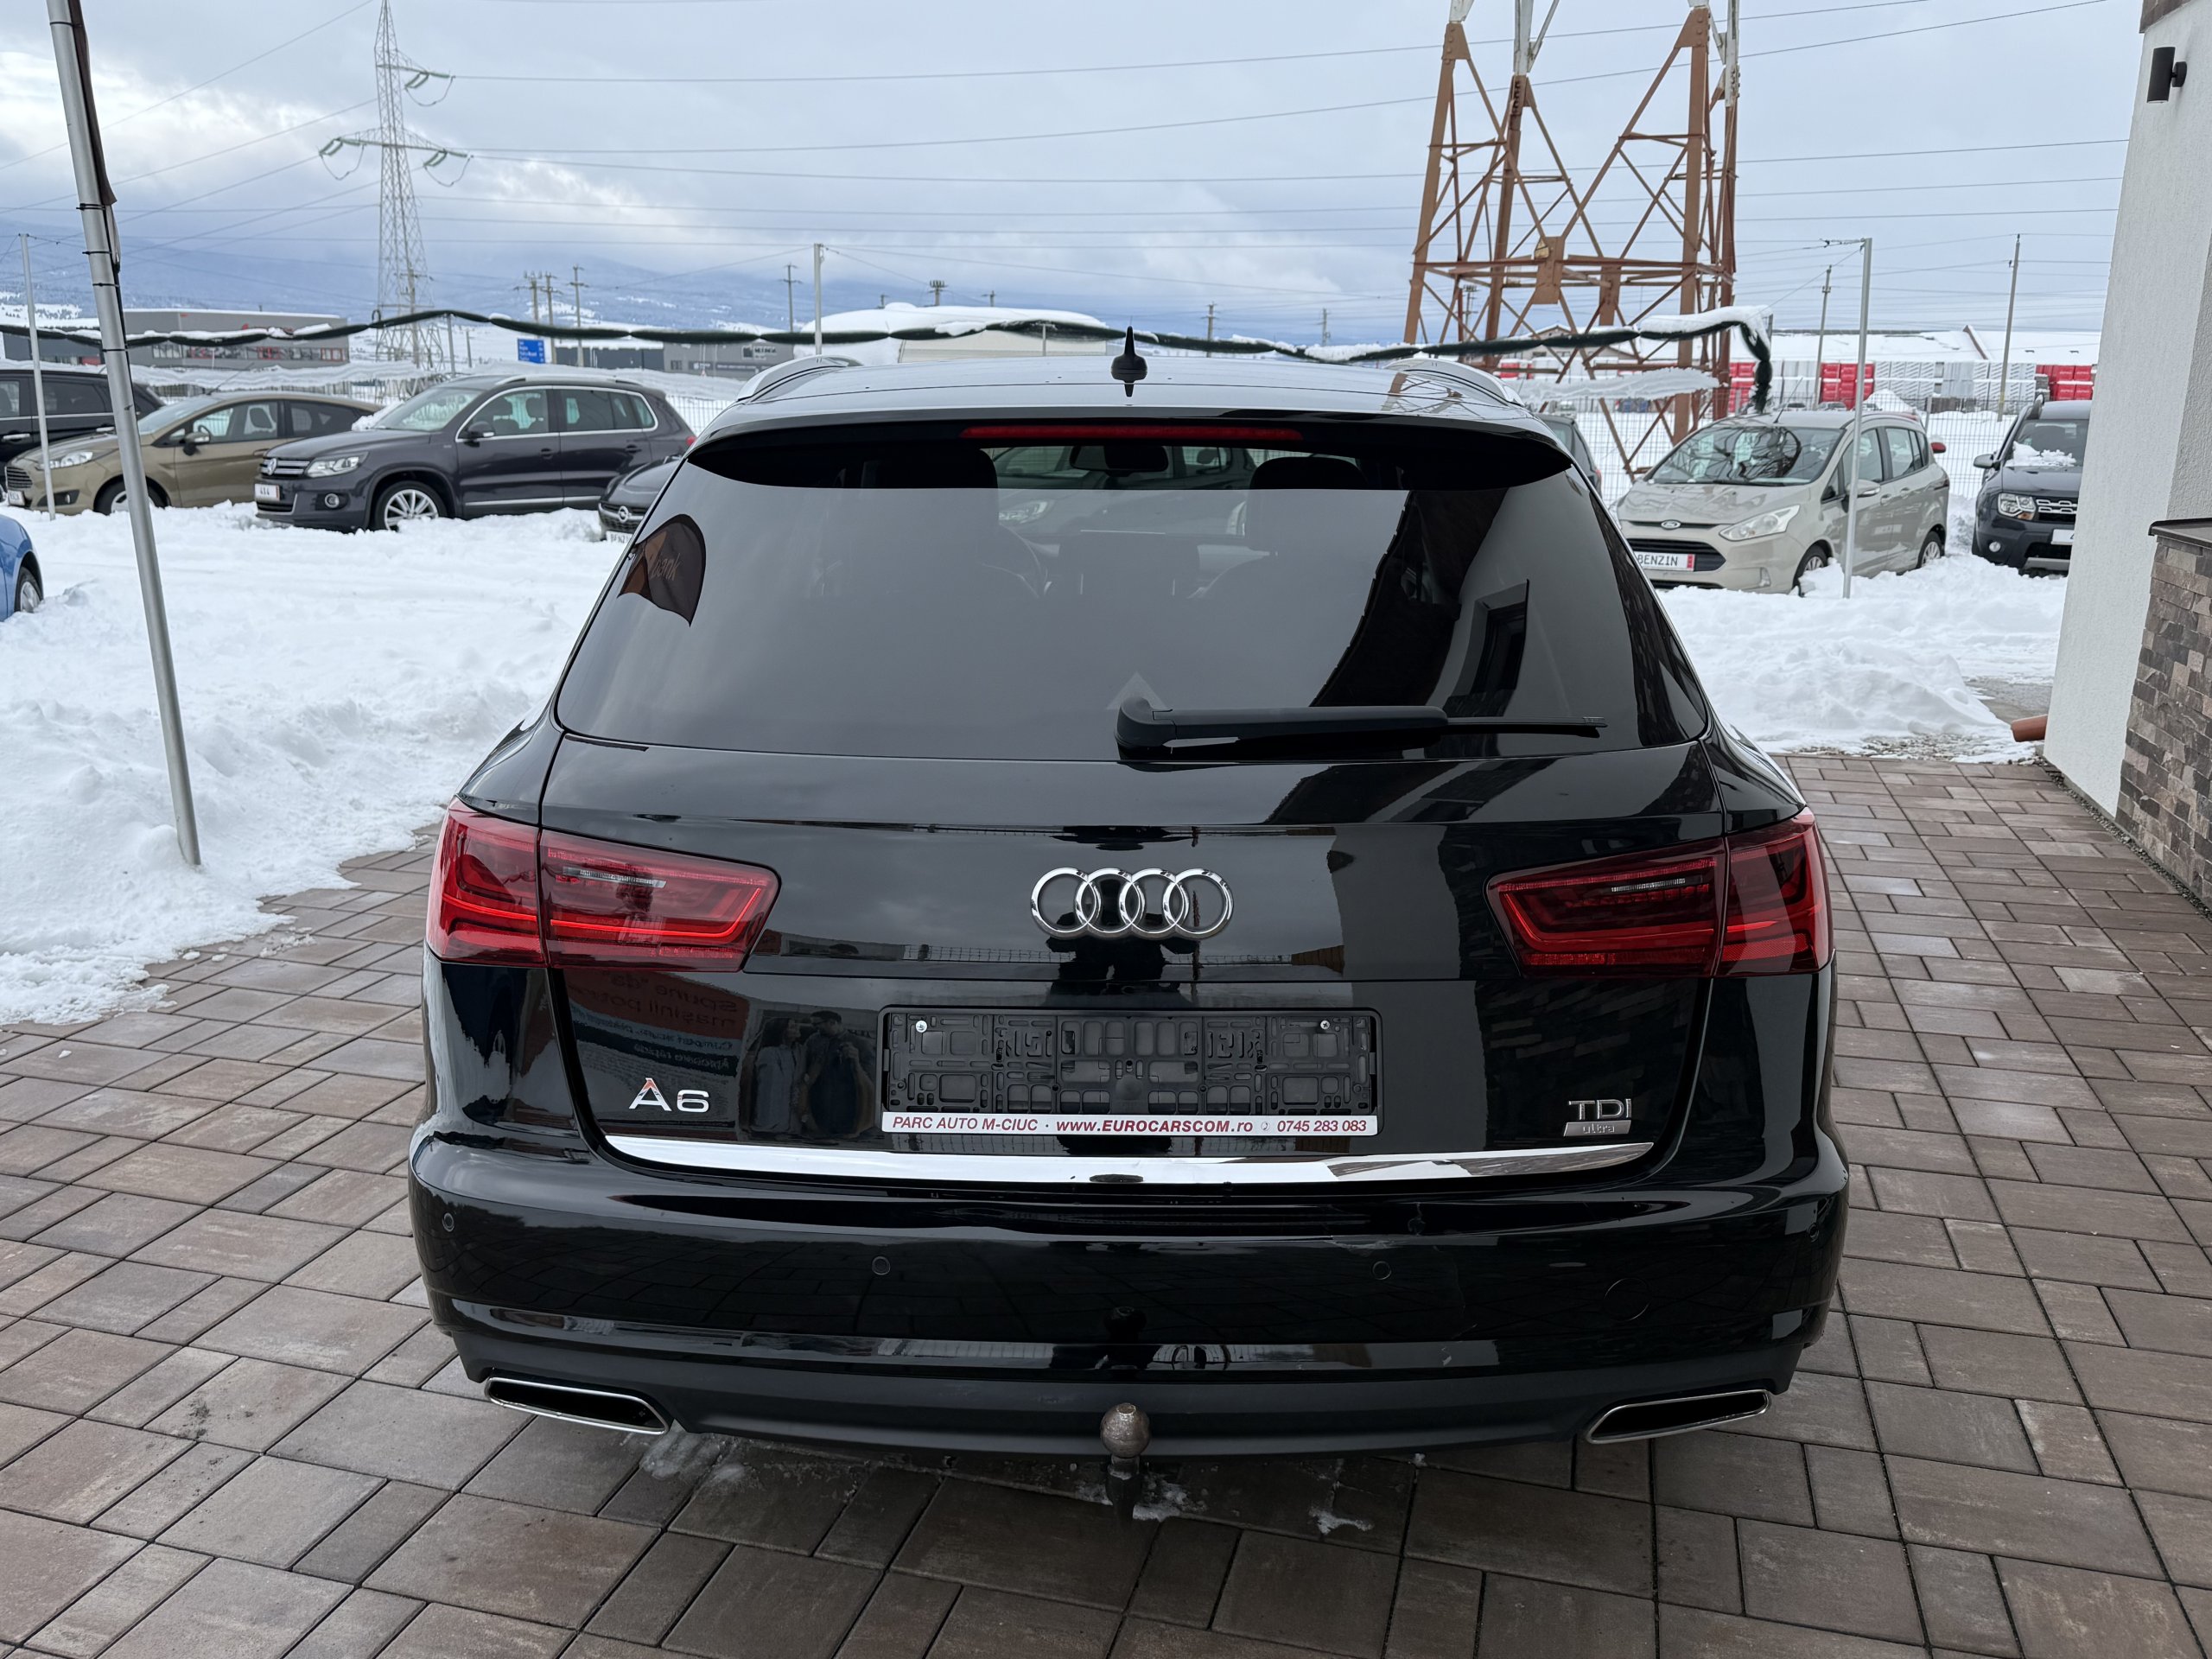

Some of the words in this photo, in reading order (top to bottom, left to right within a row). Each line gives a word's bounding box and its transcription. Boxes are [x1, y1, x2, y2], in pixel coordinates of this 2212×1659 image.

[1637, 555, 1678, 566] BENZIN
[630, 1077, 709, 1113] A6
[1568, 1098, 1631, 1120] TDI
[893, 1116, 932, 1128] PARC
[936, 1116, 977, 1129] AUTO
[982, 1118, 1038, 1131] M-CIUC
[1056, 1120, 1253, 1133] www.EUROCARSCOM.ro
[1277, 1120, 1310, 1132] 0745
[1313, 1120, 1338, 1132] 283
[1342, 1120, 1367, 1132] 083
[1582, 1122, 1615, 1134] ultra
